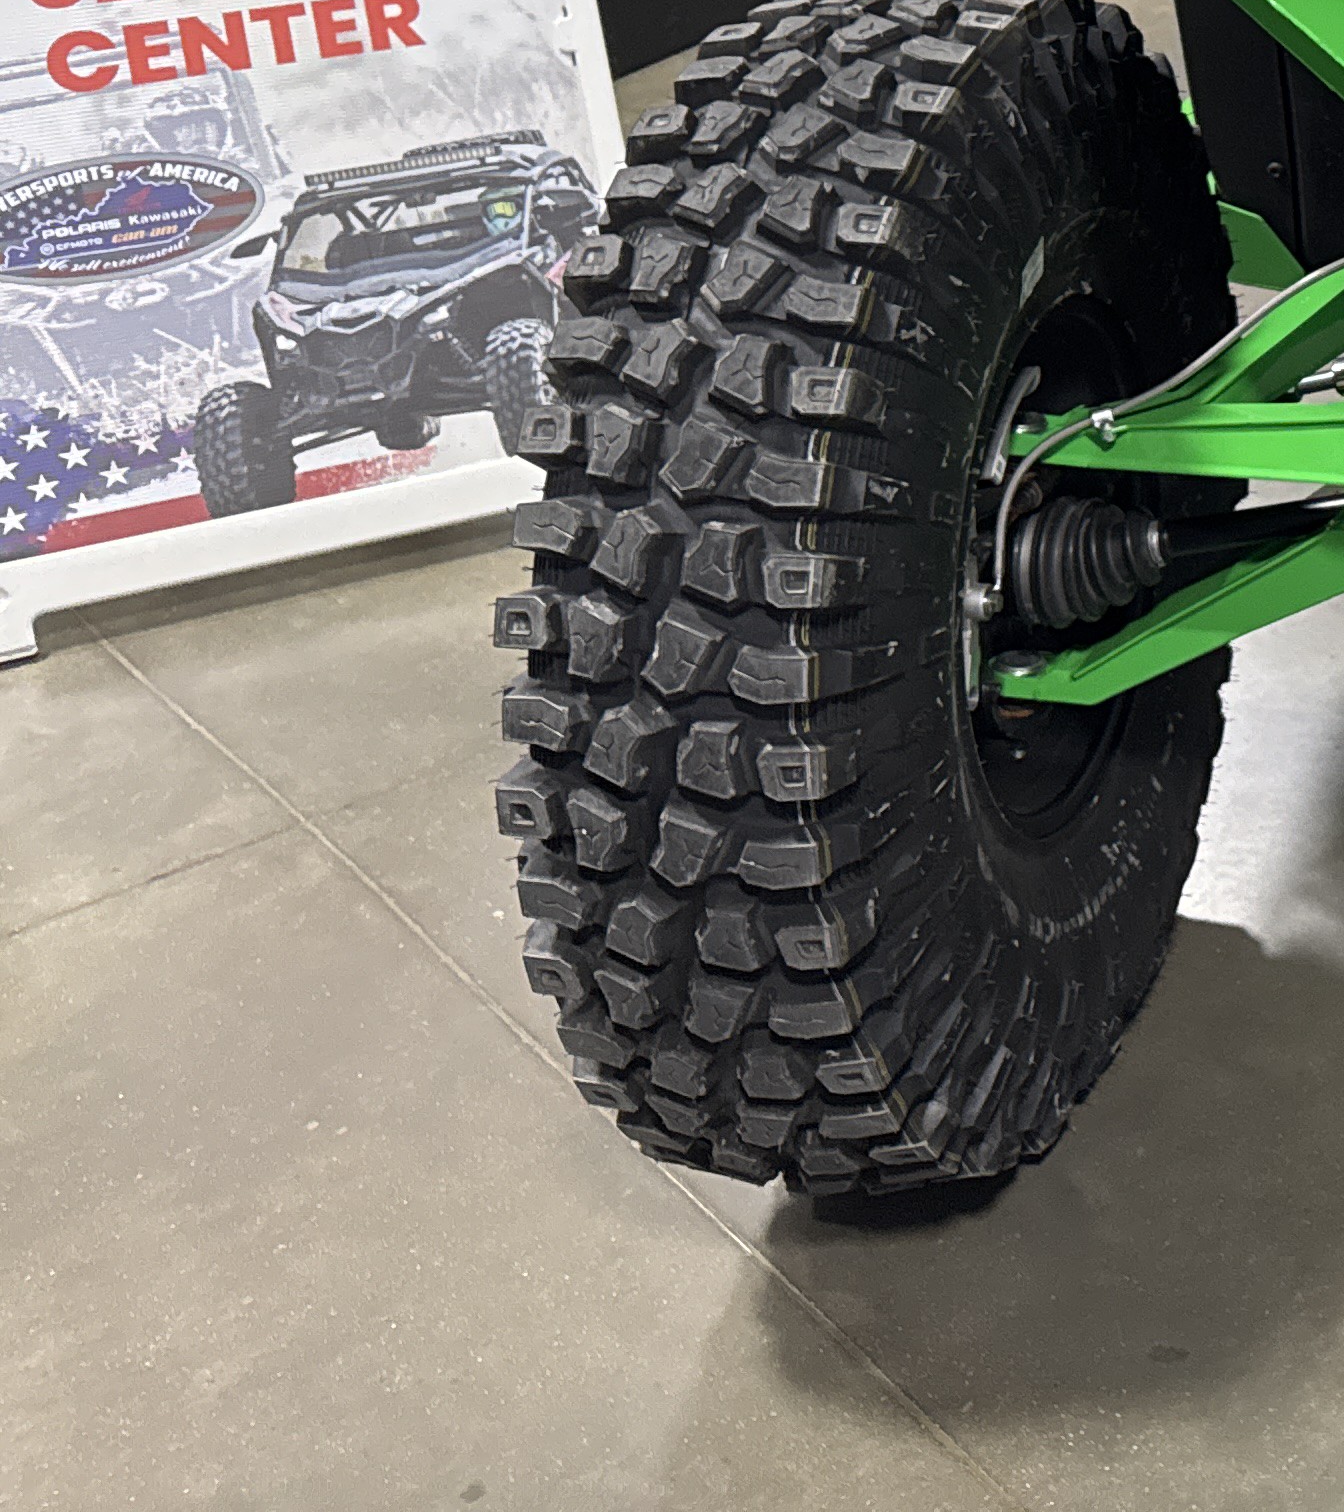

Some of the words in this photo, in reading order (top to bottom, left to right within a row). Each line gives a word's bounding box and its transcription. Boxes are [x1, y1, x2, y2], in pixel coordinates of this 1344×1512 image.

[149, 162, 240, 192] AMERICA
[42, 218, 122, 240] POLARIS
[128, 205, 202, 226] Kawasaki
